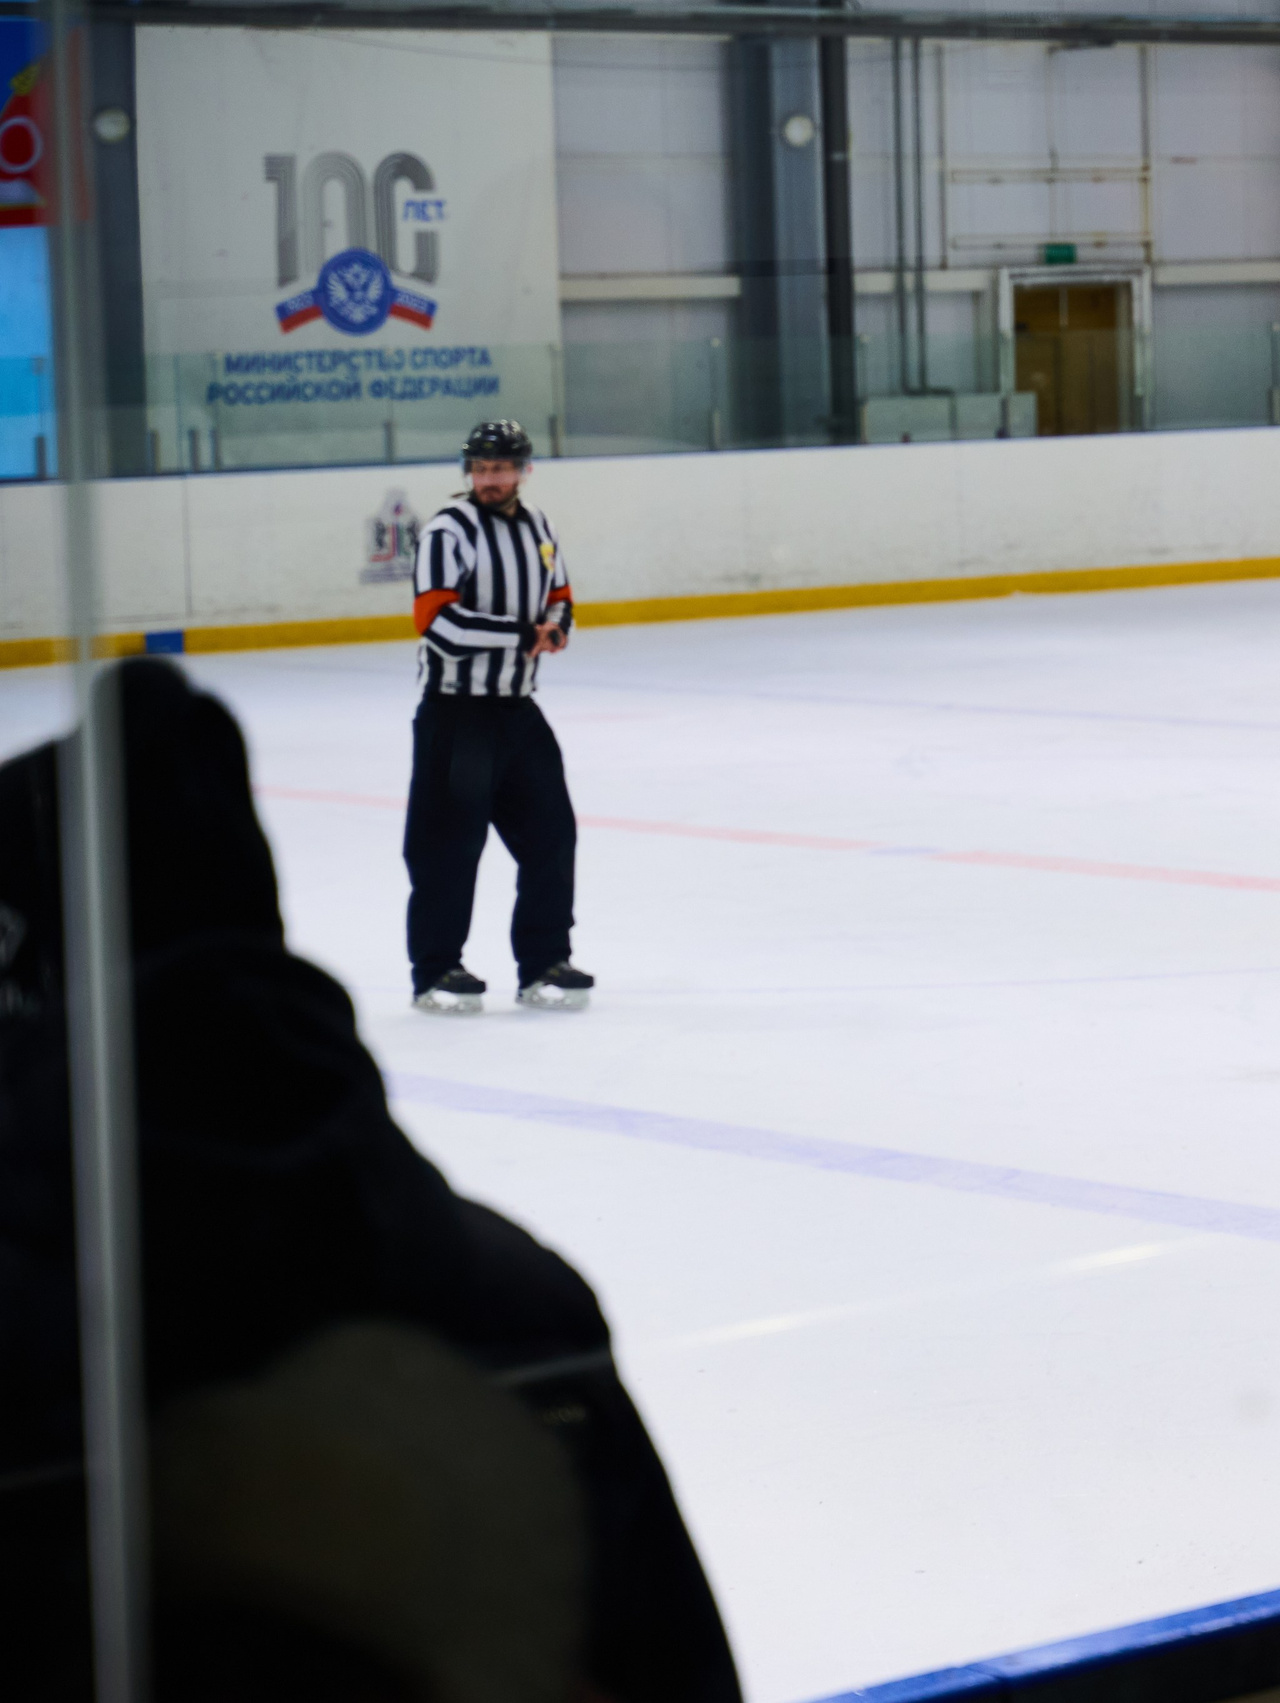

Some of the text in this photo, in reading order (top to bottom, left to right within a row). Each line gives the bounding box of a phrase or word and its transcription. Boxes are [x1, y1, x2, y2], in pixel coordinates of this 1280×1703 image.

[403, 199, 446, 221] ЛЕТ
[224, 346, 492, 374] МИНИСТЕРСТВО СПОРТА
[206, 375, 500, 406] РОССИЙСКОЙ ФЕДЕРАЦИИ
